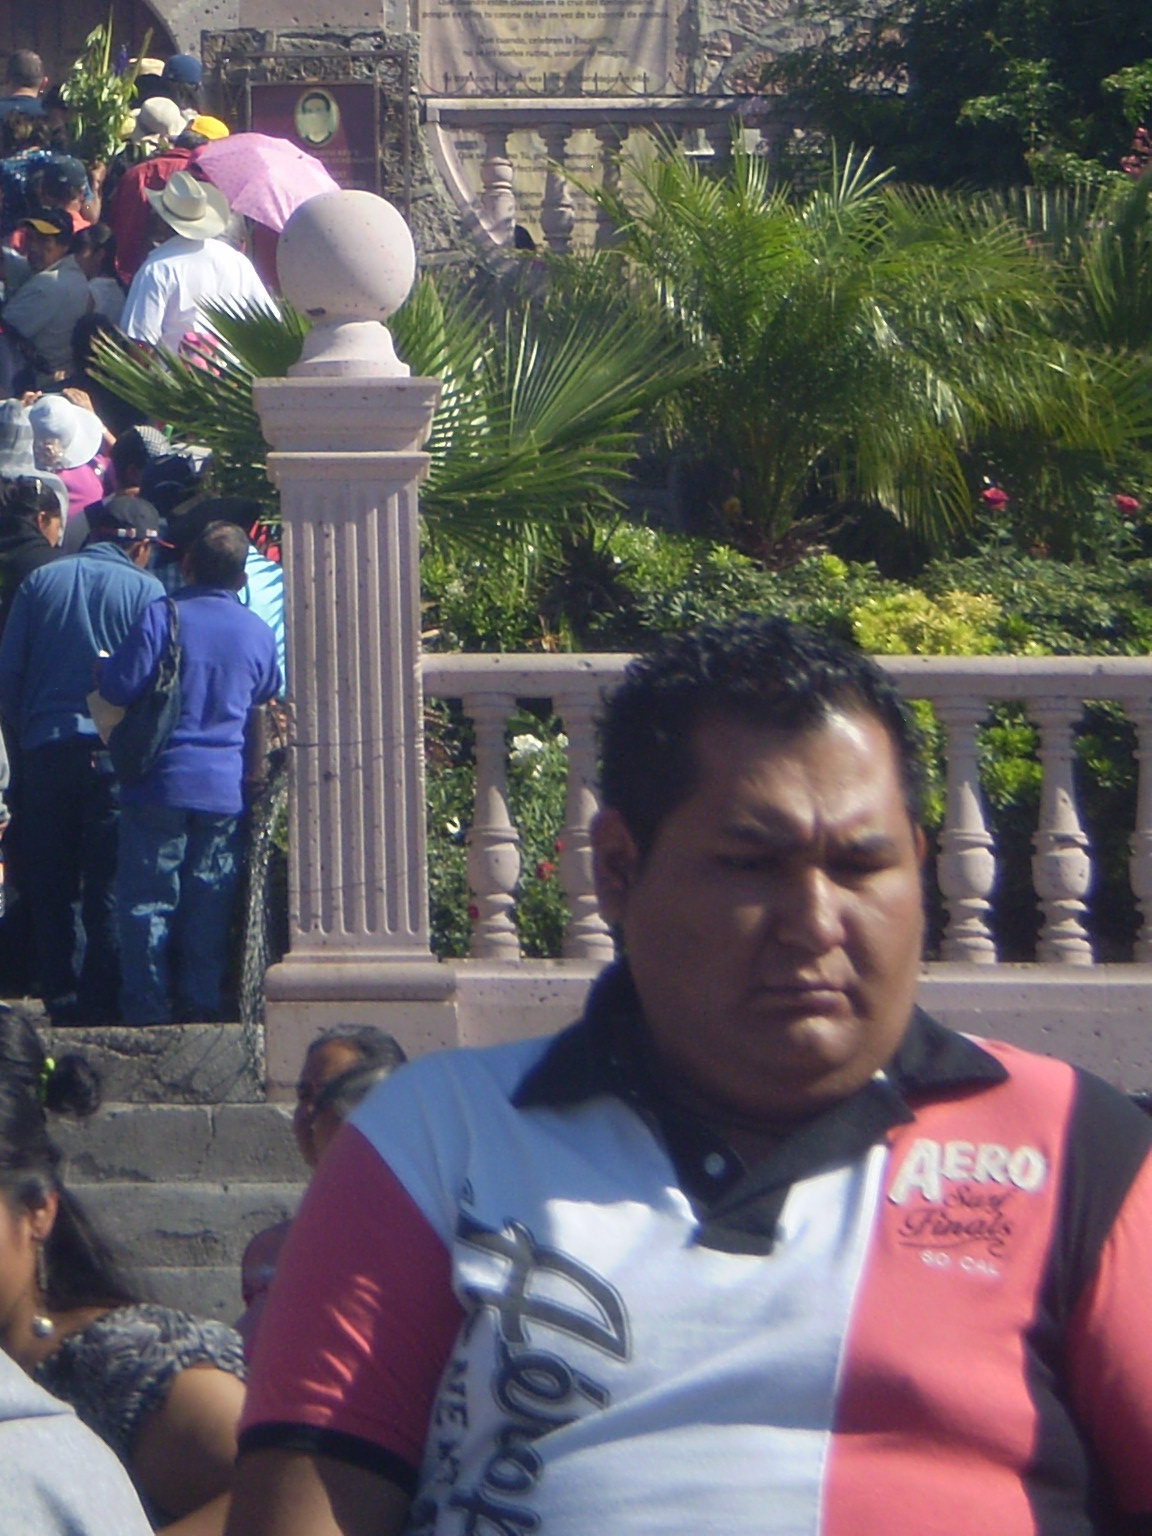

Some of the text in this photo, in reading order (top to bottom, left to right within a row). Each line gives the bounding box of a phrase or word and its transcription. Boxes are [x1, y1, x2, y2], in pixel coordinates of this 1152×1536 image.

[576, 10, 585, 18] de
[887, 1138, 1047, 1206] AERO
[898, 1207, 1014, 1246] Finals
[920, 1249, 1000, 1277] SO CAL
